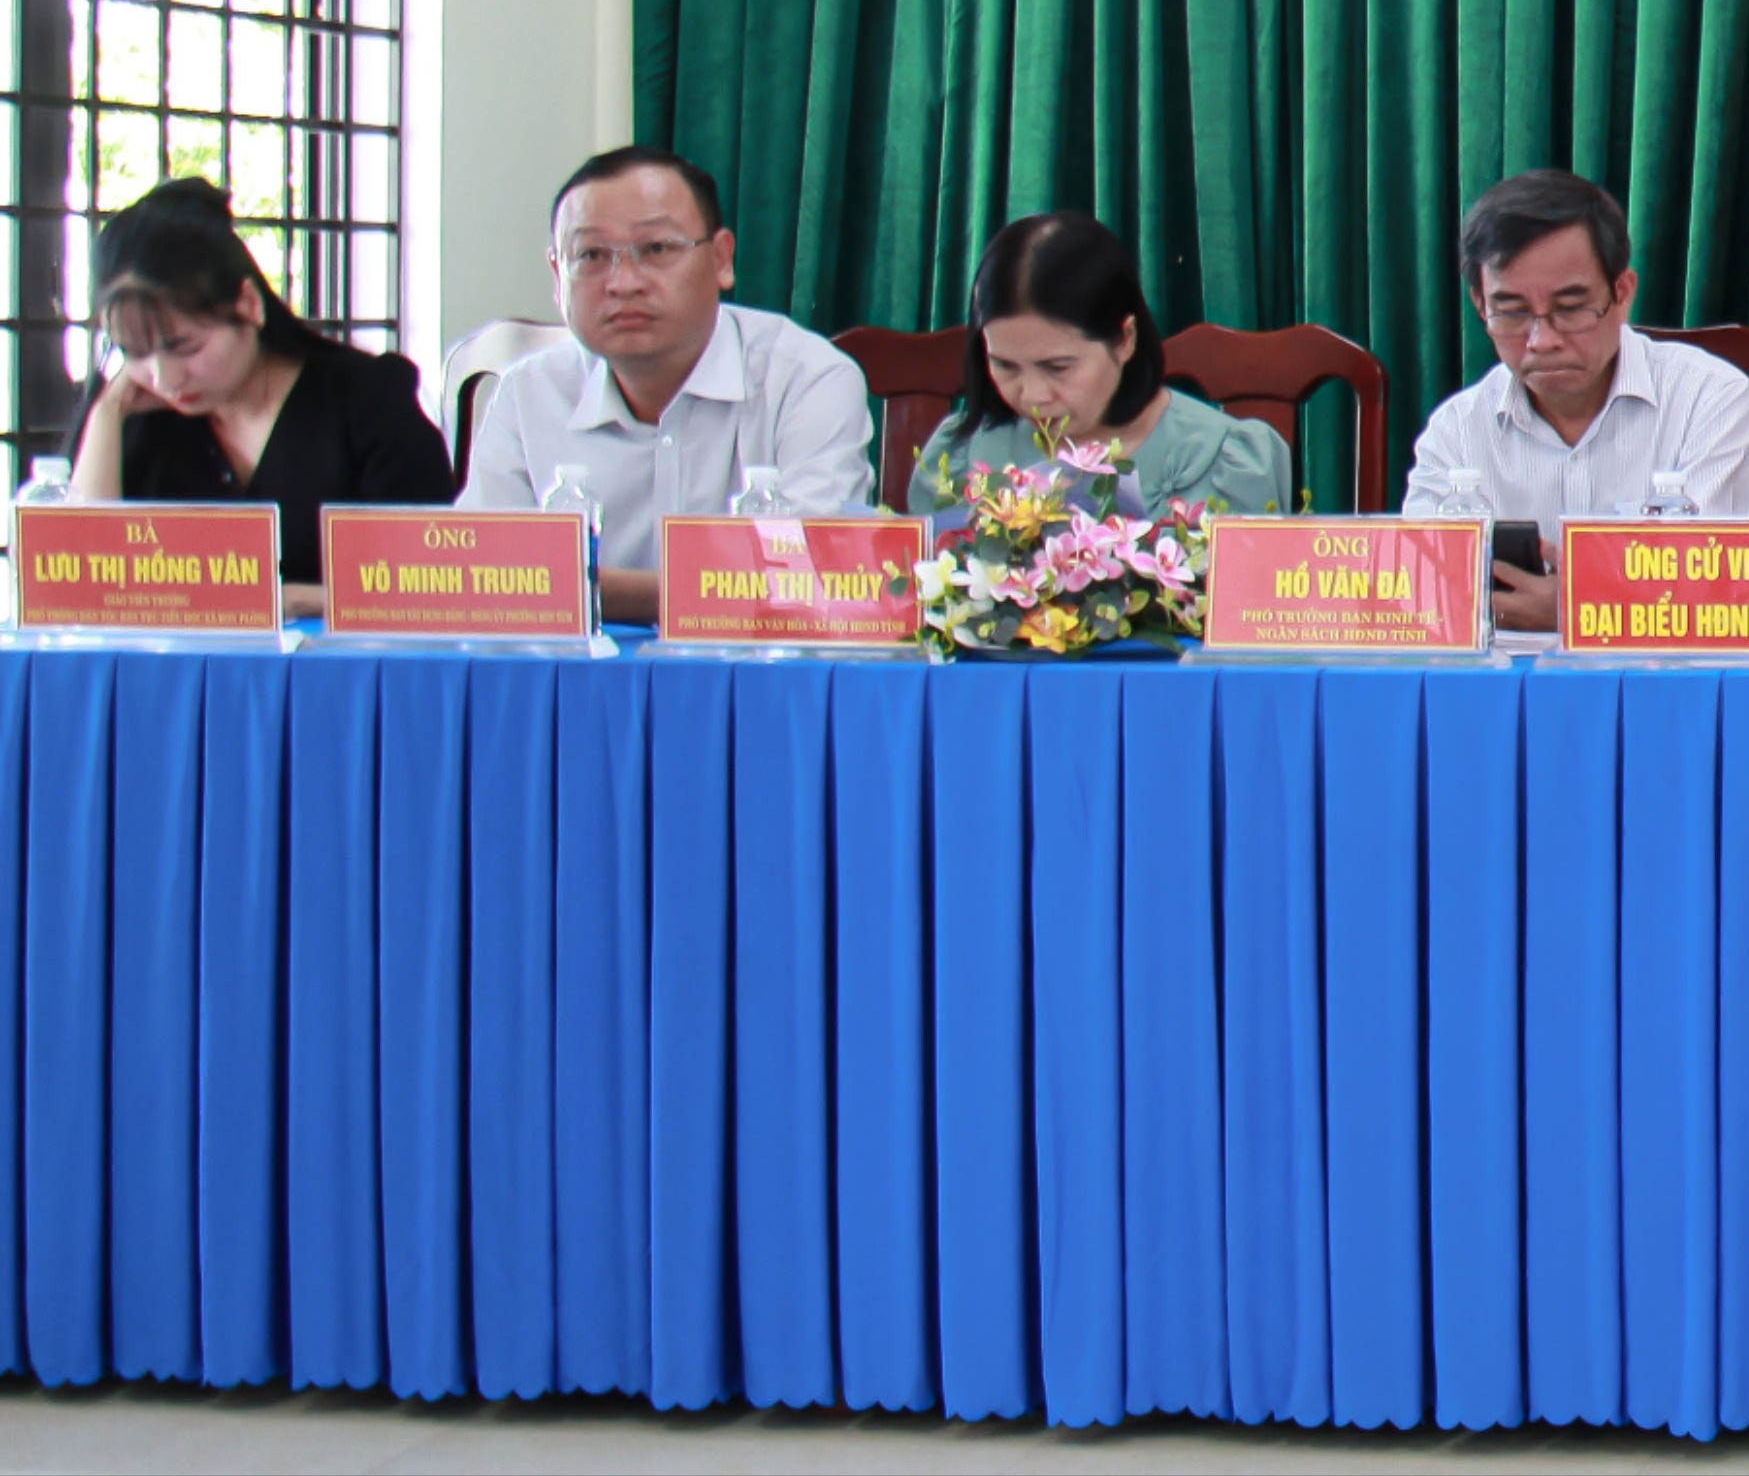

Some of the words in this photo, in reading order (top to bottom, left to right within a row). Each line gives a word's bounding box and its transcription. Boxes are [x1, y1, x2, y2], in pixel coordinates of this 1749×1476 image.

[126, 517, 159, 543] BÀ
[424, 521, 476, 548] ÔNG
[1313, 531, 1368, 557] ÔNG
[35, 553, 80, 582] LƯU
[88, 555, 125, 588] THỊ
[134, 549, 201, 583] HỒNG
[209, 552, 258, 584] VÂN
[1625, 541, 1678, 580] ỨNG
[1686, 537, 1722, 580] CỬ
[399, 566, 462, 593] MINH
[470, 566, 550, 594] TRUNG
[699, 570, 769, 600] PHAN
[776, 571, 814, 607] THỊ
[822, 563, 884, 603] THỦY
[1318, 564, 1369, 599] VĂN
[1377, 564, 1412, 599] ĐÀ
[1580, 603, 1622, 643] ĐẠI
[1631, 591, 1687, 636] BIỂU
